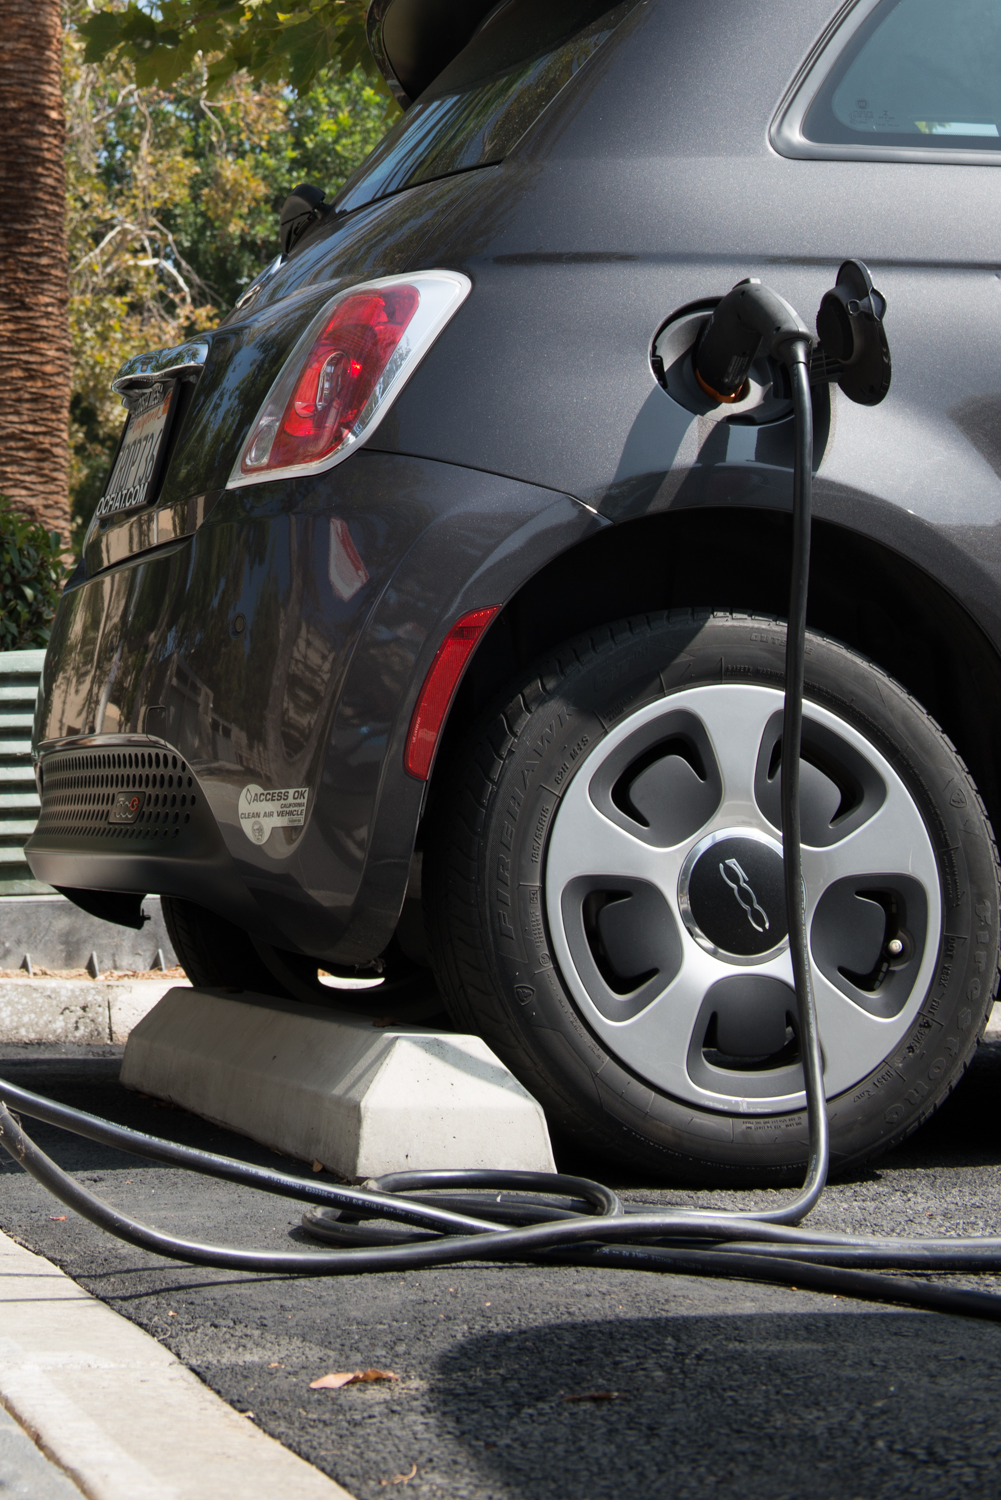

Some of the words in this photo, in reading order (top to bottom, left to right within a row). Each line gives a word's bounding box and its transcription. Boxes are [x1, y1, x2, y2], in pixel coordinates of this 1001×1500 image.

[96, 482, 149, 516] OCFIAT.COM
[251, 791, 289, 803] ACCESS
[293, 789, 307, 800] OK
[240, 811, 261, 820] CLEAN
[263, 810, 275, 818] AIR
[277, 808, 305, 817] VEHICLE
[497, 705, 578, 941] FIREHAWK
